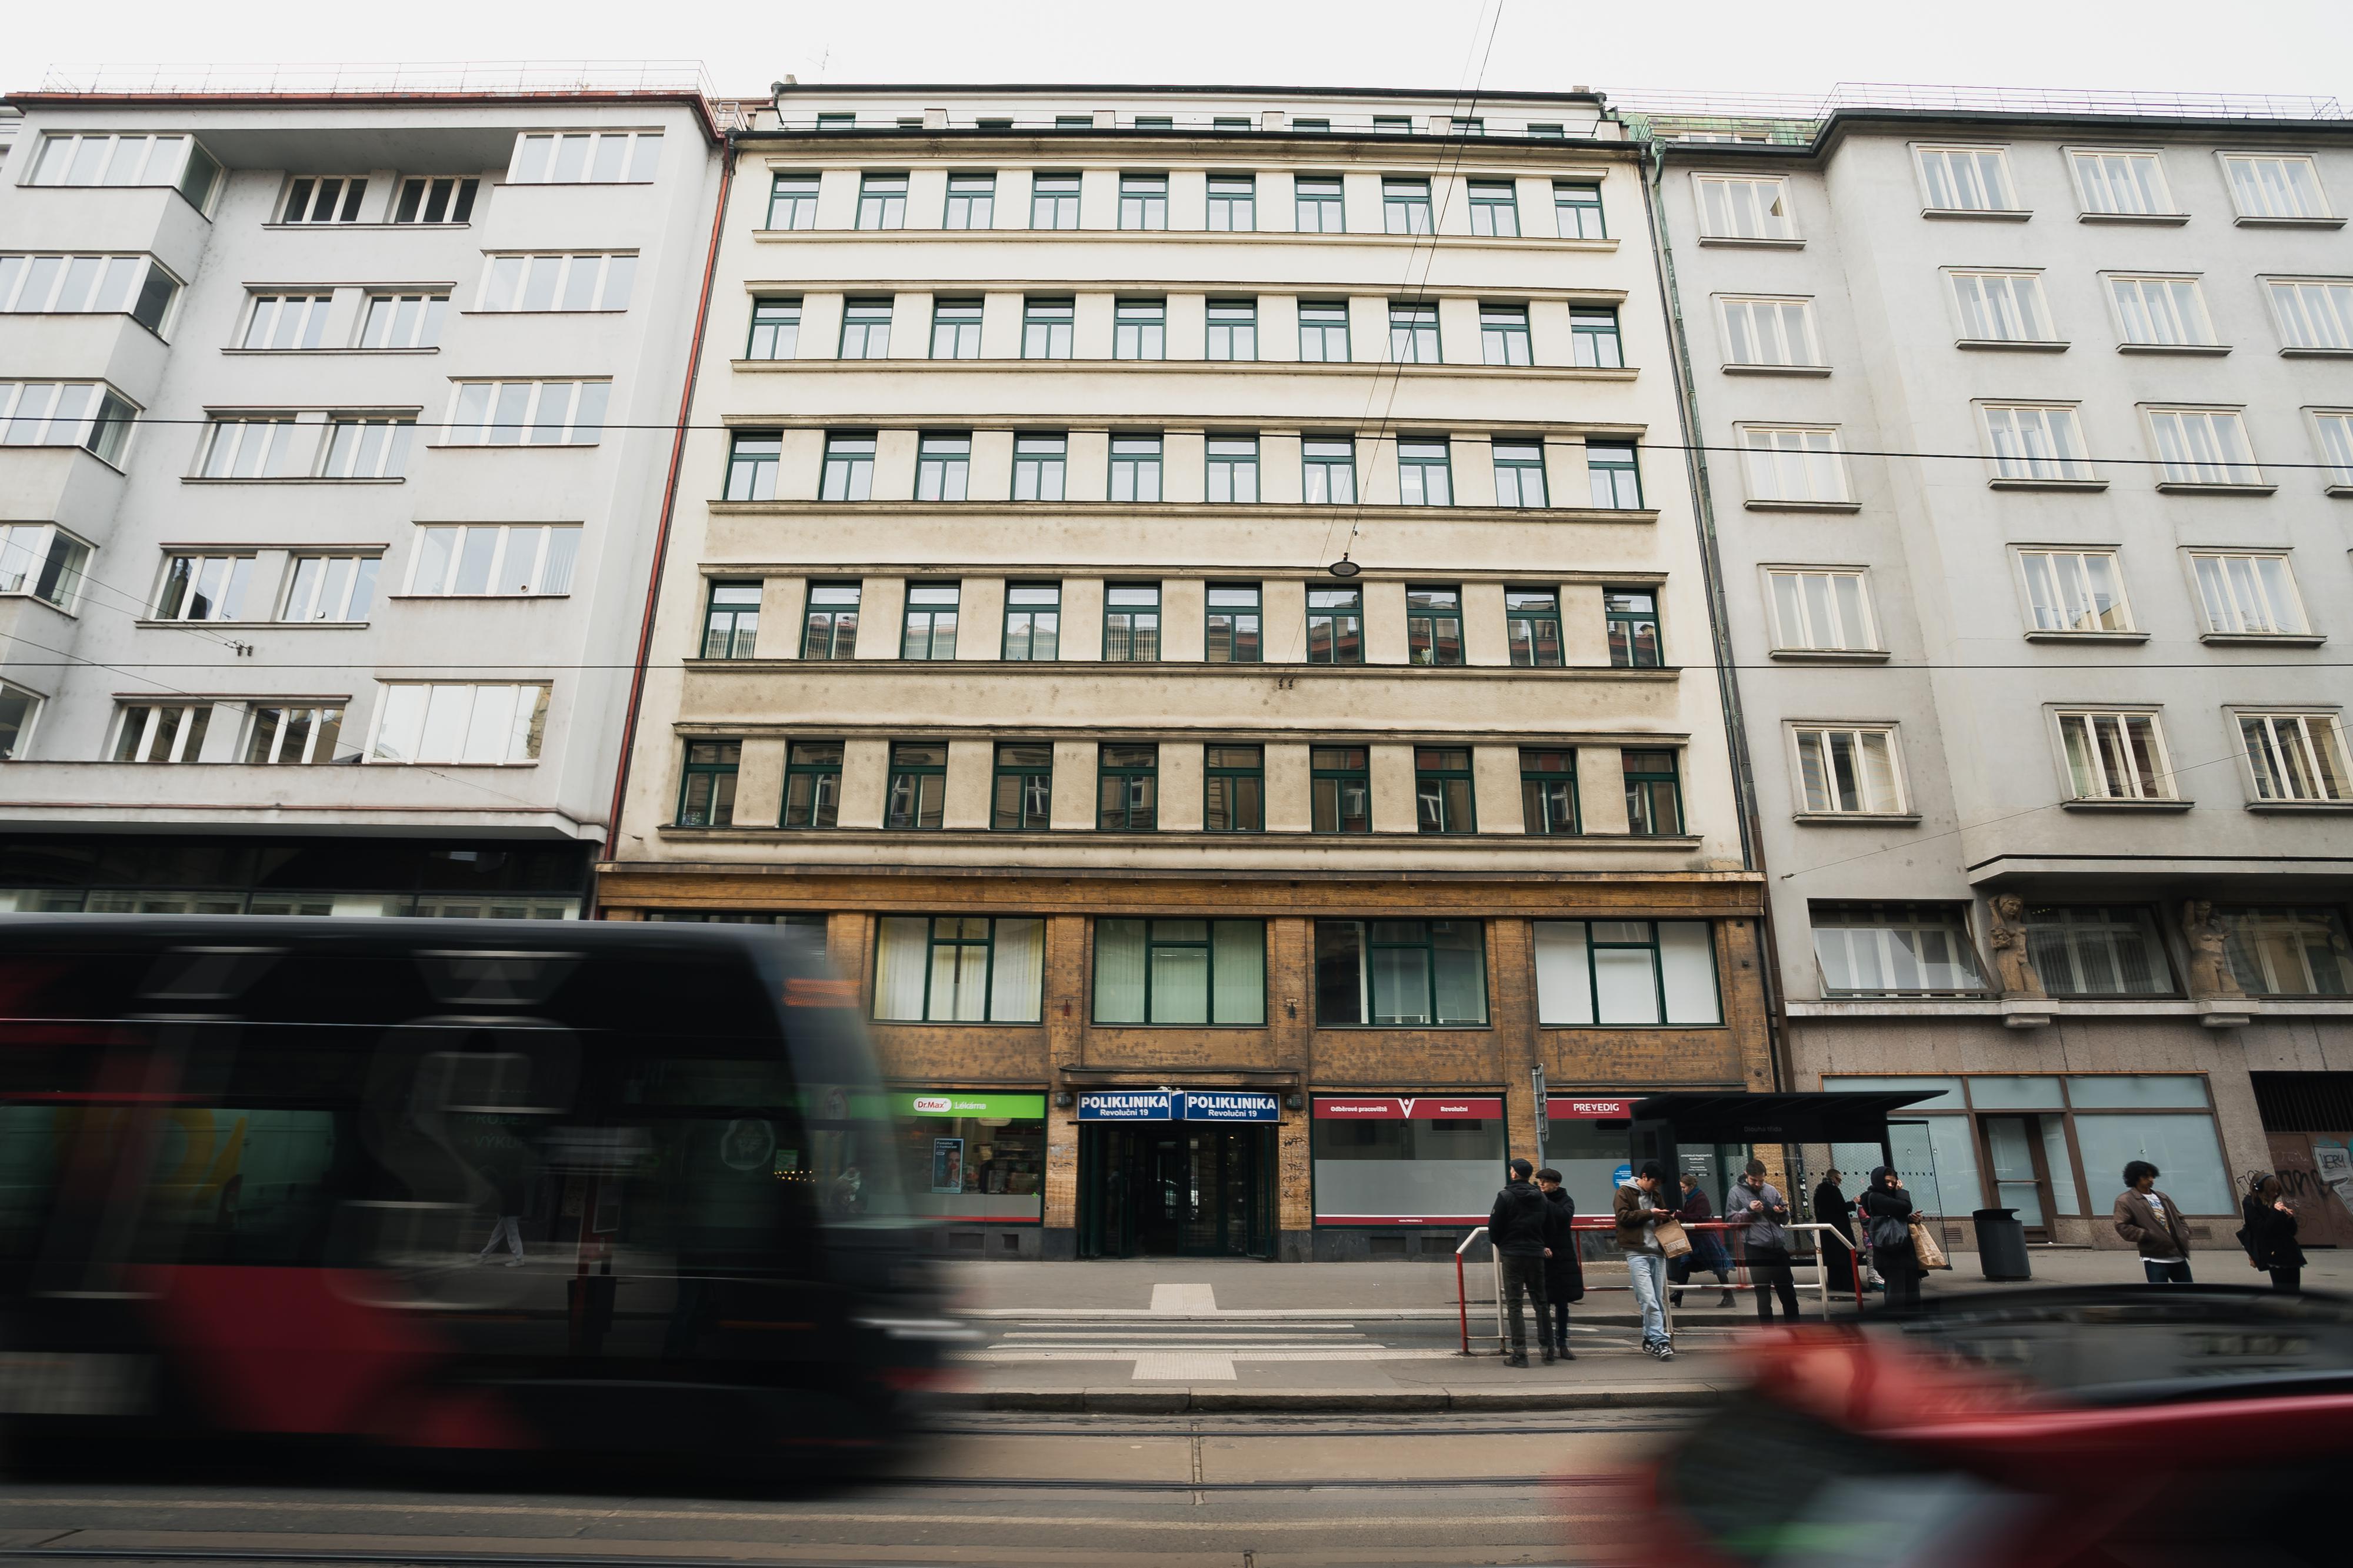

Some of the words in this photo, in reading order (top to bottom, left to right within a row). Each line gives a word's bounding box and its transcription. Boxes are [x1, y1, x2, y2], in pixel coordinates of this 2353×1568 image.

[1081, 1096, 1169, 1108] POLIKLINIKA
[1188, 1096, 1277, 1110] POLIKLINIKA
[1573, 1103, 1619, 1112] PREVEDIG
